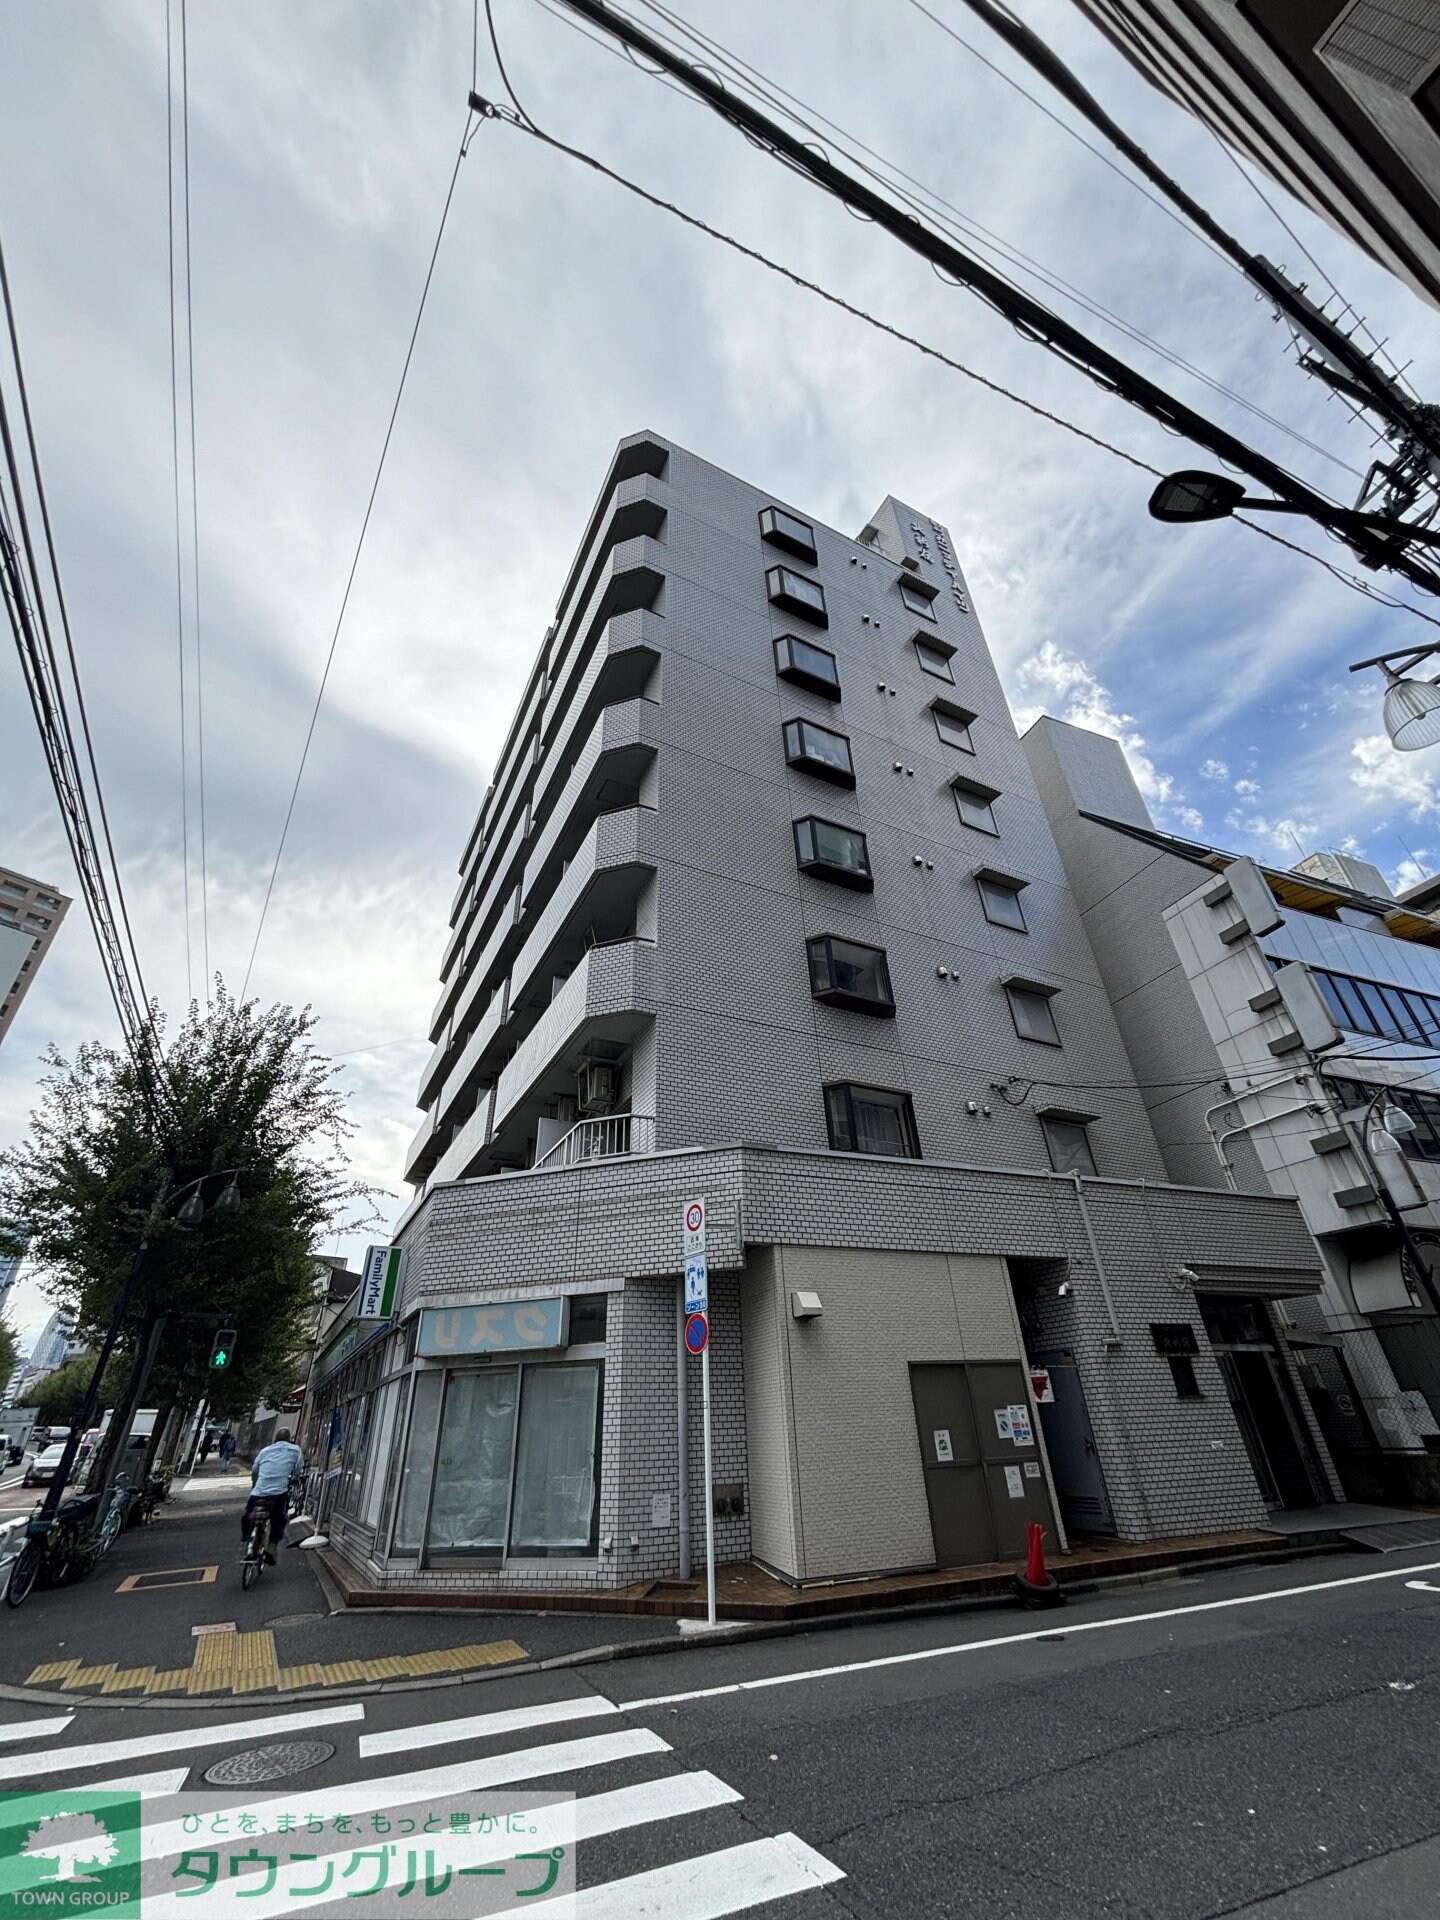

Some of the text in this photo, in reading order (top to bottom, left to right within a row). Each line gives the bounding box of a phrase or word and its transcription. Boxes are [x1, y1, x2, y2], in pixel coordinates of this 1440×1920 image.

[690, 1211, 700, 1225] 30
[366, 1250, 387, 1315] FamilyMart
[686, 1300, 706, 1313] ゾーン30
